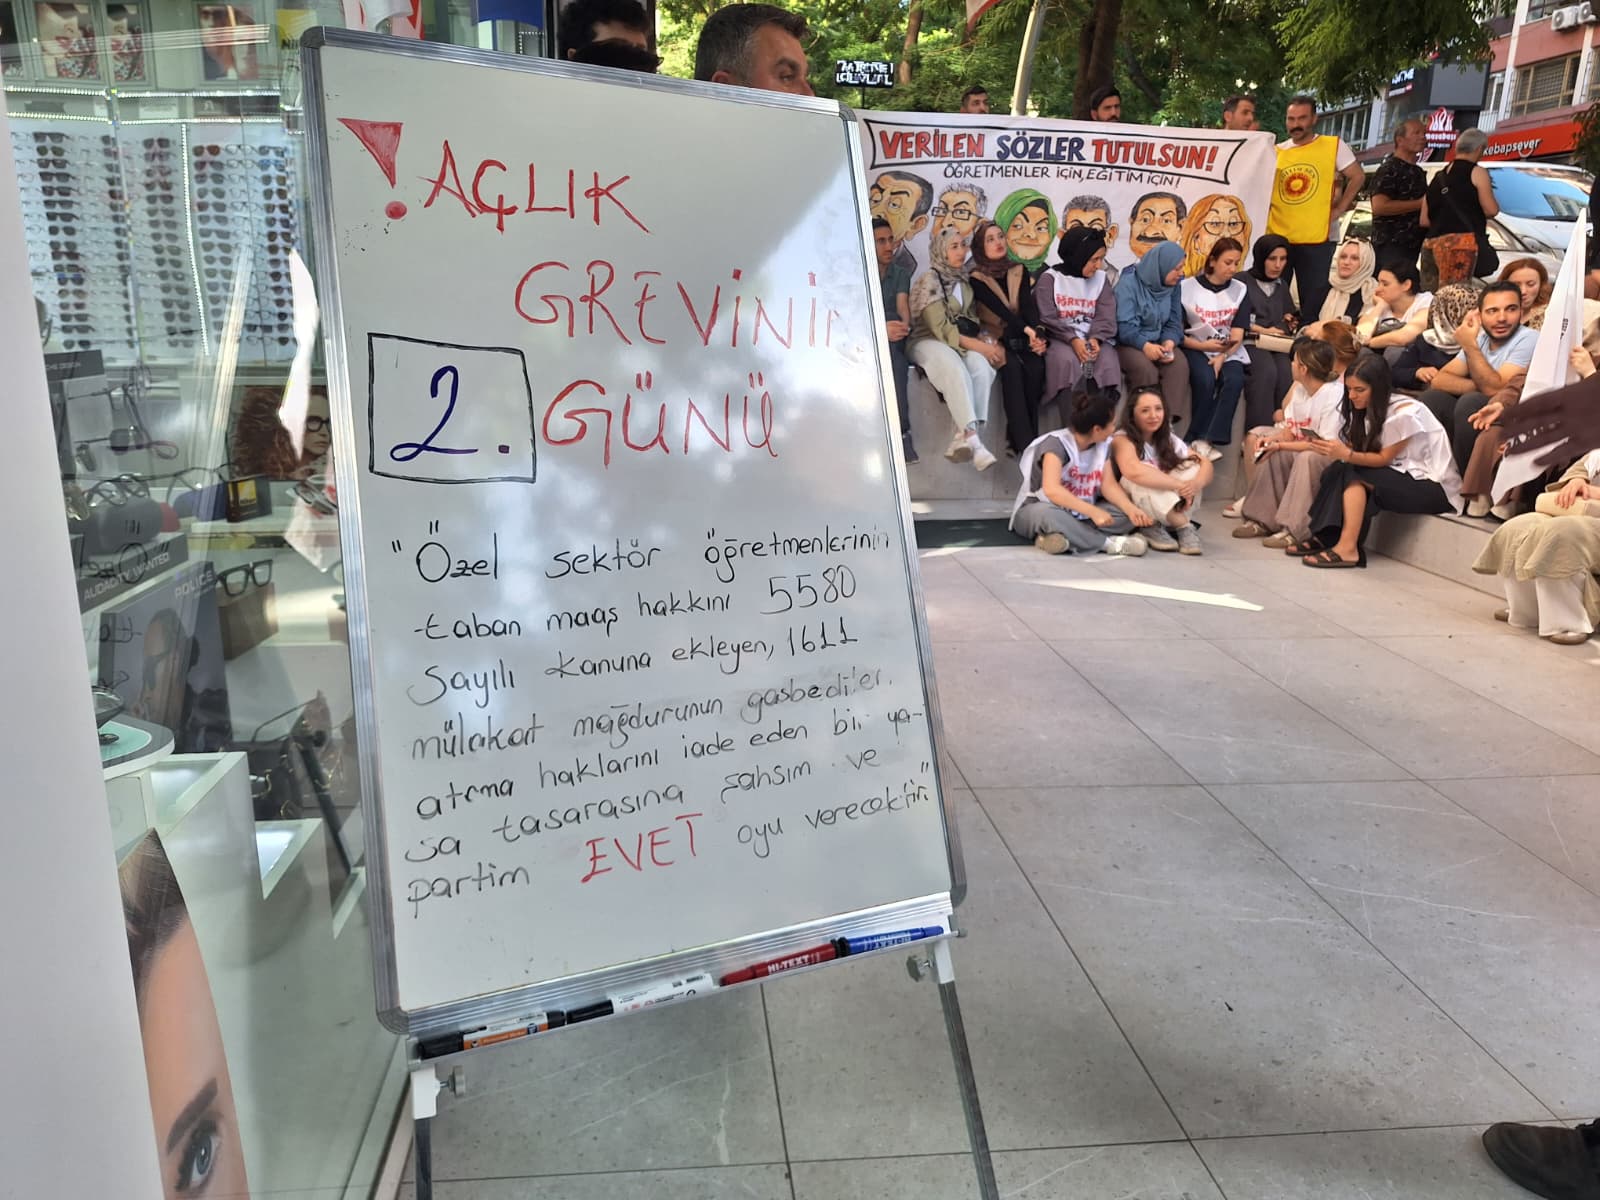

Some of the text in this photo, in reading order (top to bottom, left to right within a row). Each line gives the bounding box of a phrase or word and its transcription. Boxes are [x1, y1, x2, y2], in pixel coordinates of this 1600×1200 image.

[880, 129, 1219, 171] VERİLEN SÖZLER TUTULSUN!
[943, 162, 1051, 178] ÖĞRETMENLER
[418, 140, 654, 234] AÇLIK
[390, 365, 779, 469] 2. GÜNÜ
[175, 570, 214, 600] POLICE
[545, 538, 661, 579] sektör
[546, 607, 618, 637] maaş
[637, 590, 731, 617] hakkını
[760, 565, 857, 614] 5580
[789, 616, 858, 656] 1611
[539, 750, 658, 788] haklarını
[681, 732, 736, 759] iade
[749, 720, 808, 746] eden
[492, 784, 684, 843] tasarasına
[846, 749, 881, 770] ve
[407, 862, 530, 919] partim
[581, 813, 703, 884] EVET
[737, 817, 783, 858] oyu
[767, 954, 811, 974] HI-TEXT
